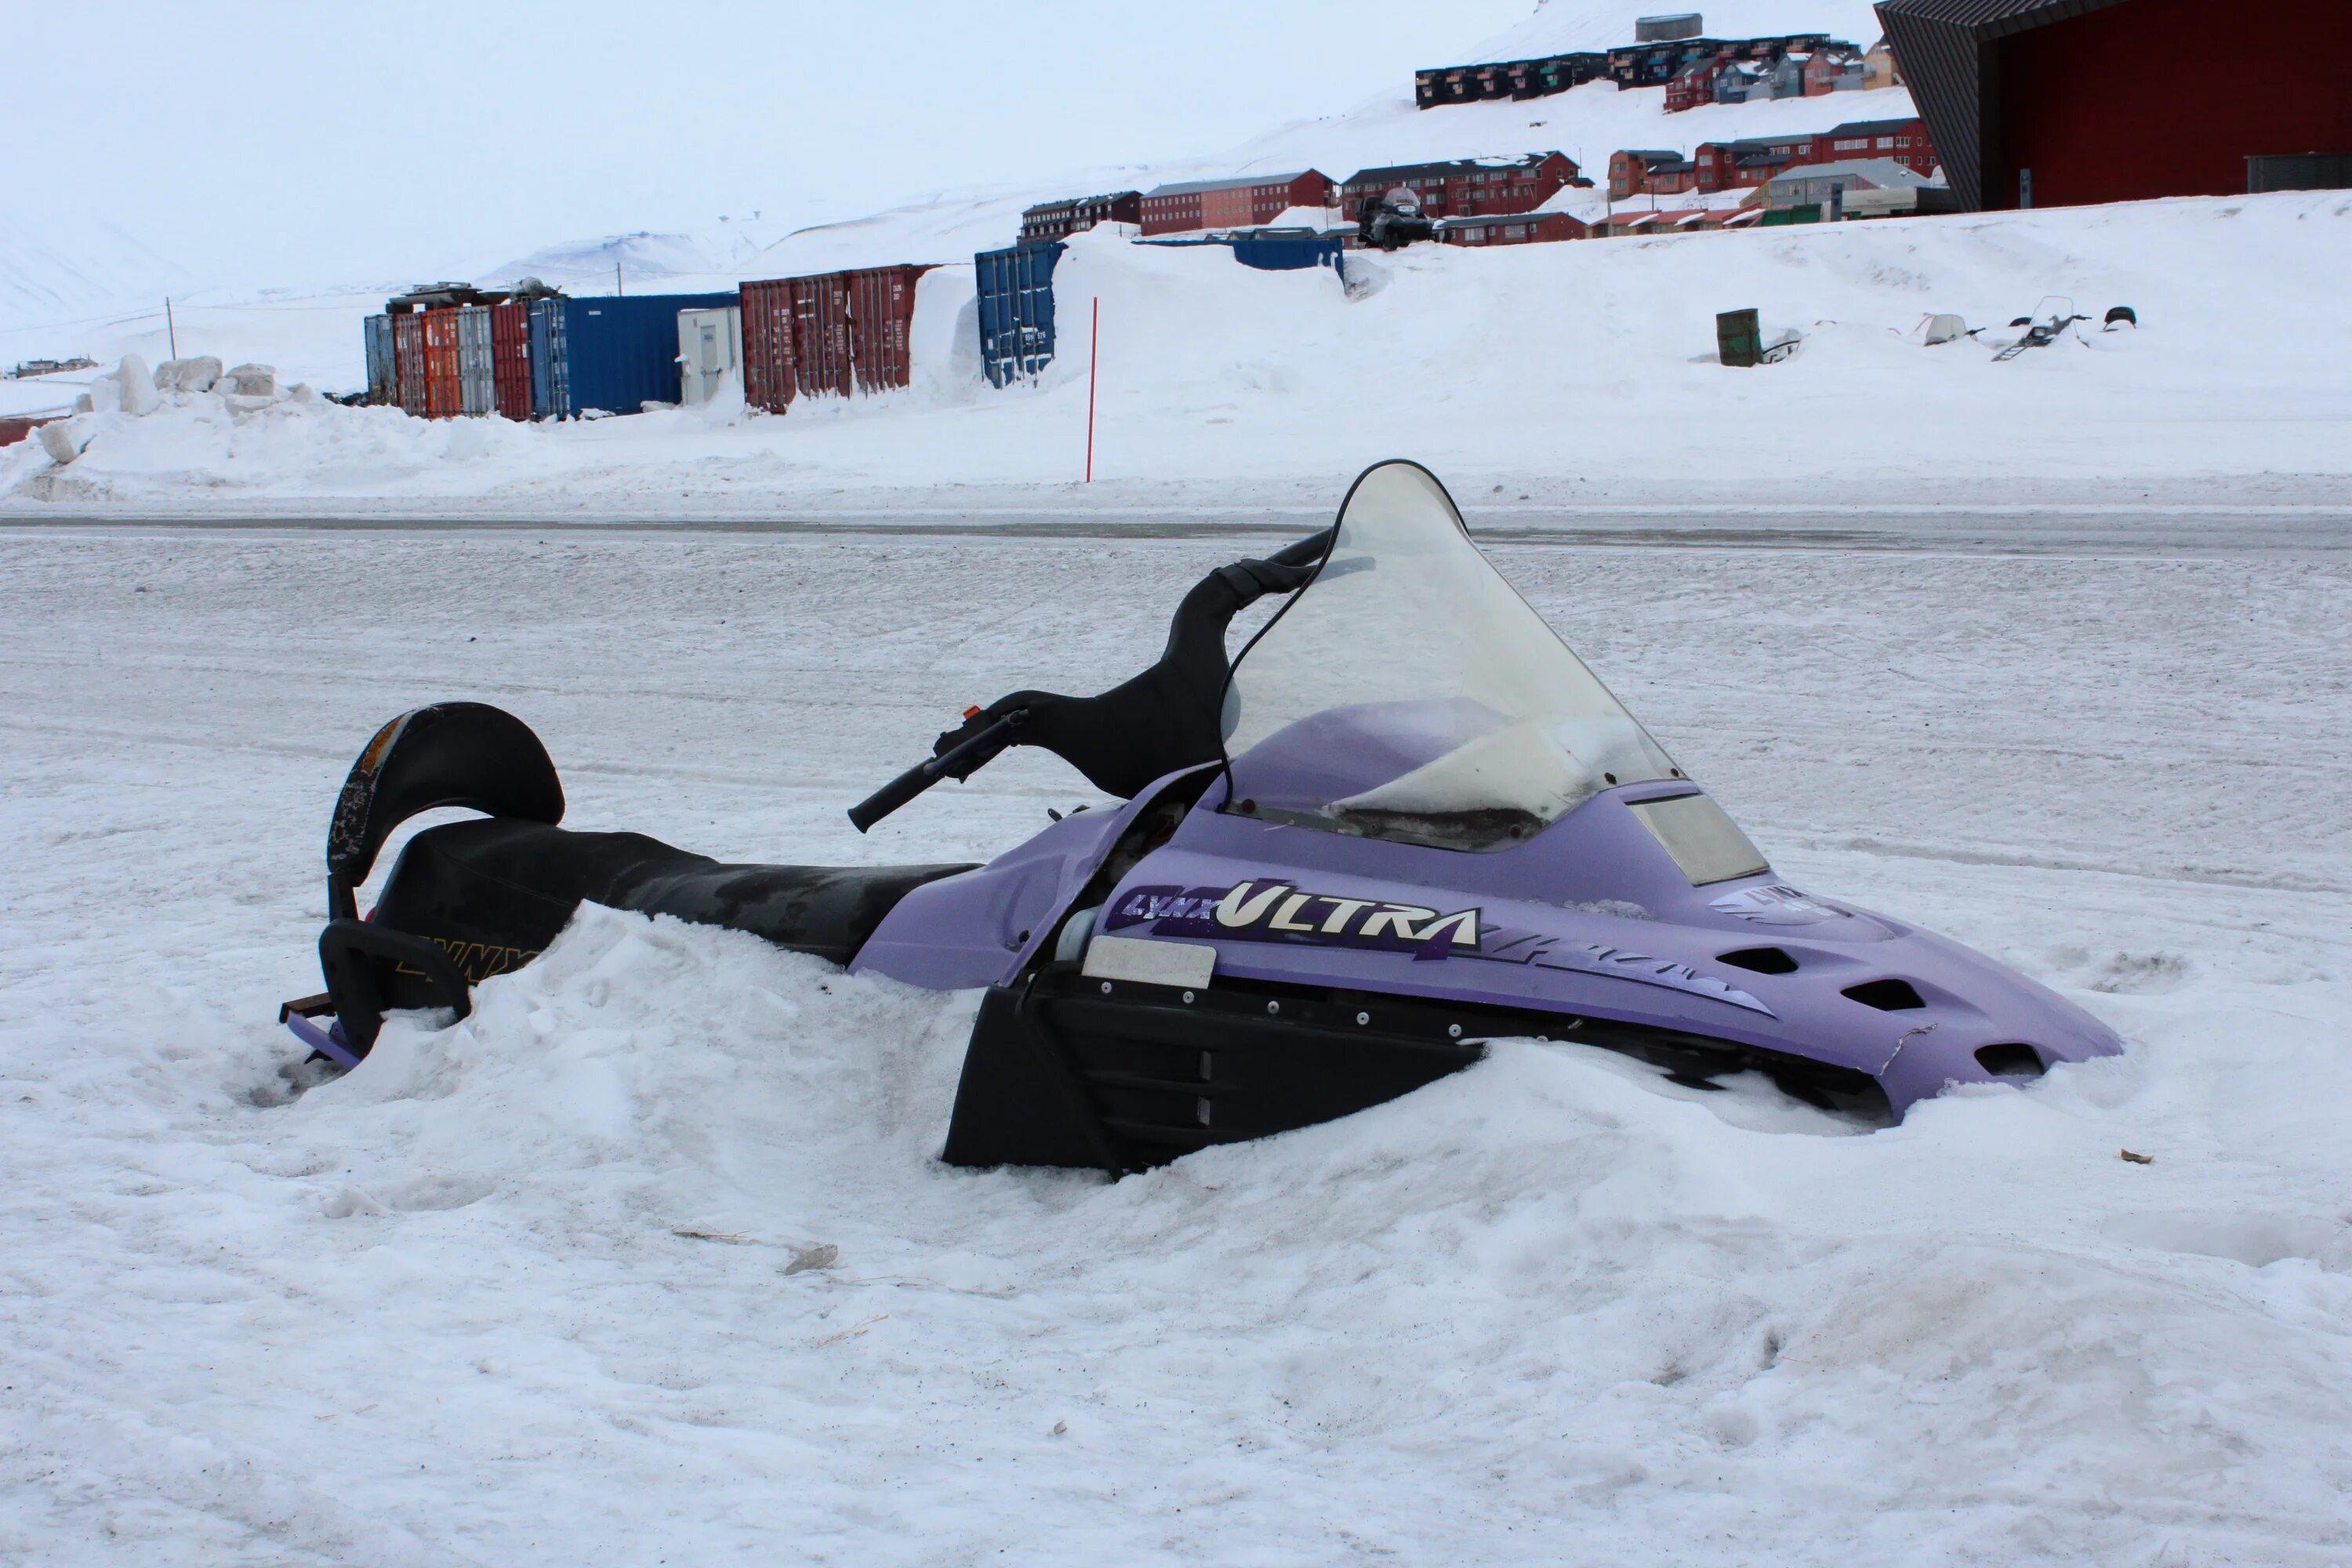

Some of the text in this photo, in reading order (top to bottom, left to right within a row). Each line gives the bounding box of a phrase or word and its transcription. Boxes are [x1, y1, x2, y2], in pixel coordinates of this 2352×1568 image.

[1121, 882, 1476, 945] LYNX ULTRA
[1743, 885, 1809, 906] LYNX
